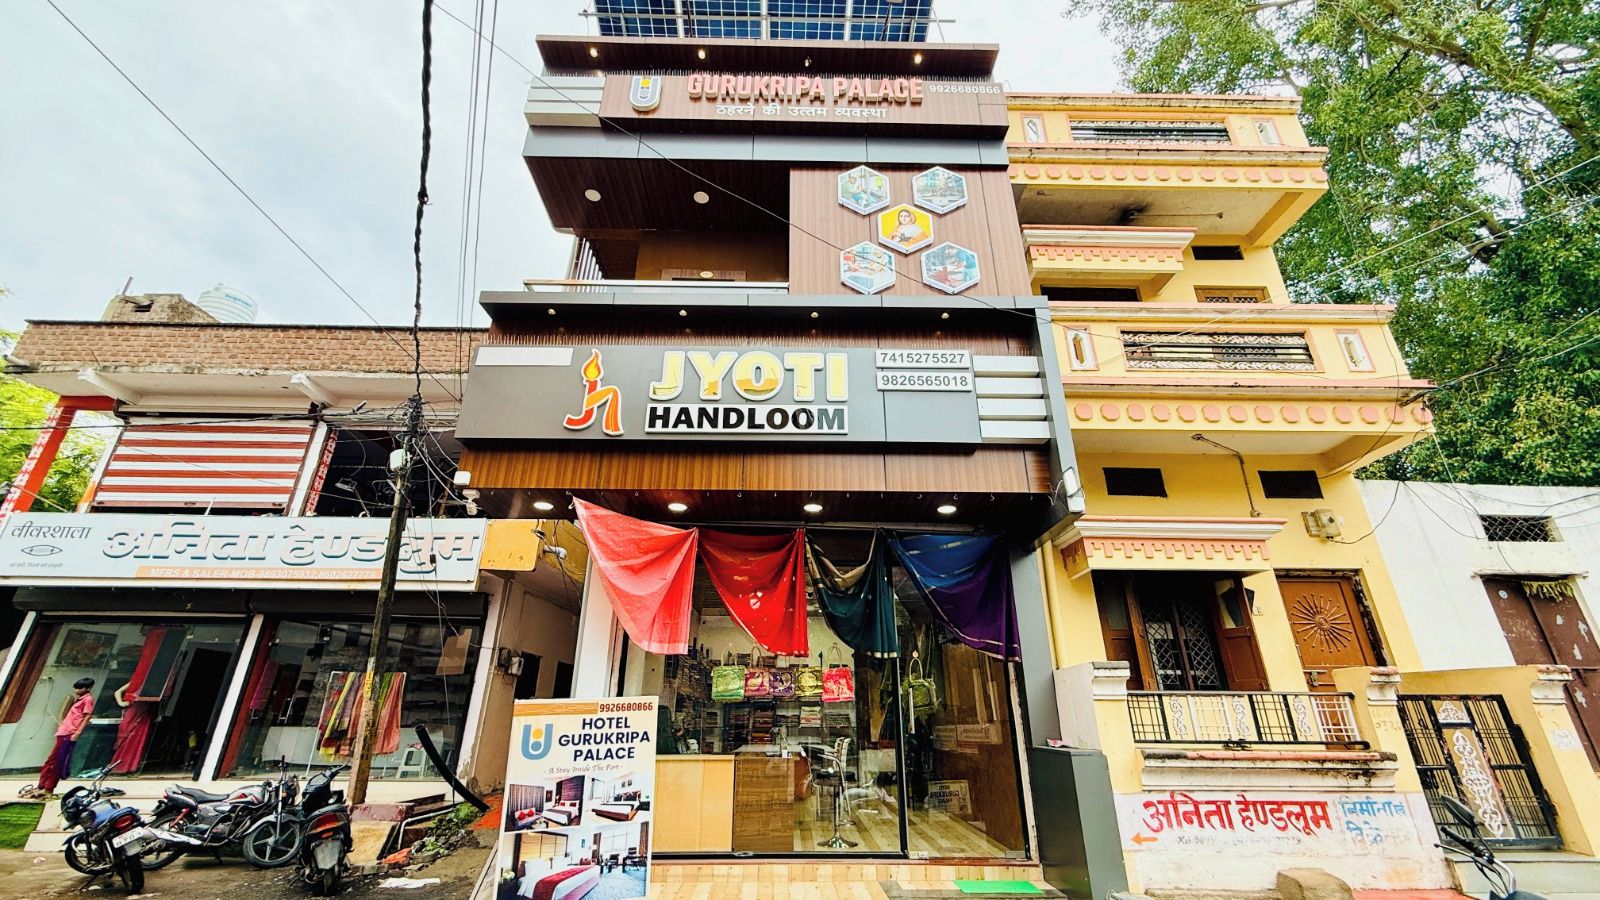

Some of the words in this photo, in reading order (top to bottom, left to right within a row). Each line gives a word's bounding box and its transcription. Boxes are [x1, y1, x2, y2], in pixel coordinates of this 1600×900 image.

[688, 73, 826, 101] GURUKRIPA
[833, 77, 924, 104] PALACE
[929, 83, 1001, 95] 9926680866
[716, 102, 755, 116] ठहरने
[762, 103, 781, 116] की
[788, 105, 827, 117] उत्तम
[834, 107, 888, 118] व्यवस्था
[879, 352, 965, 364] 7415275527
[648, 351, 849, 402] JYOTI
[881, 374, 969, 388] 9826565018
[647, 406, 846, 430] HANDLOOM
[11, 520, 92, 540] वीवरशाला
[102, 522, 275, 560] अनिता
[599, 702, 654, 713] 9926680866
[581, 717, 631, 731] HOTEL
[558, 731, 651, 747] GURUKRIPA
[573, 747, 636, 762] PALACE
[556, 766, 571, 774] Stay
[592, 763, 604, 771] The
[1142, 790, 1235, 832] अनिता
[1235, 793, 1333, 838] हेण्डलूम
